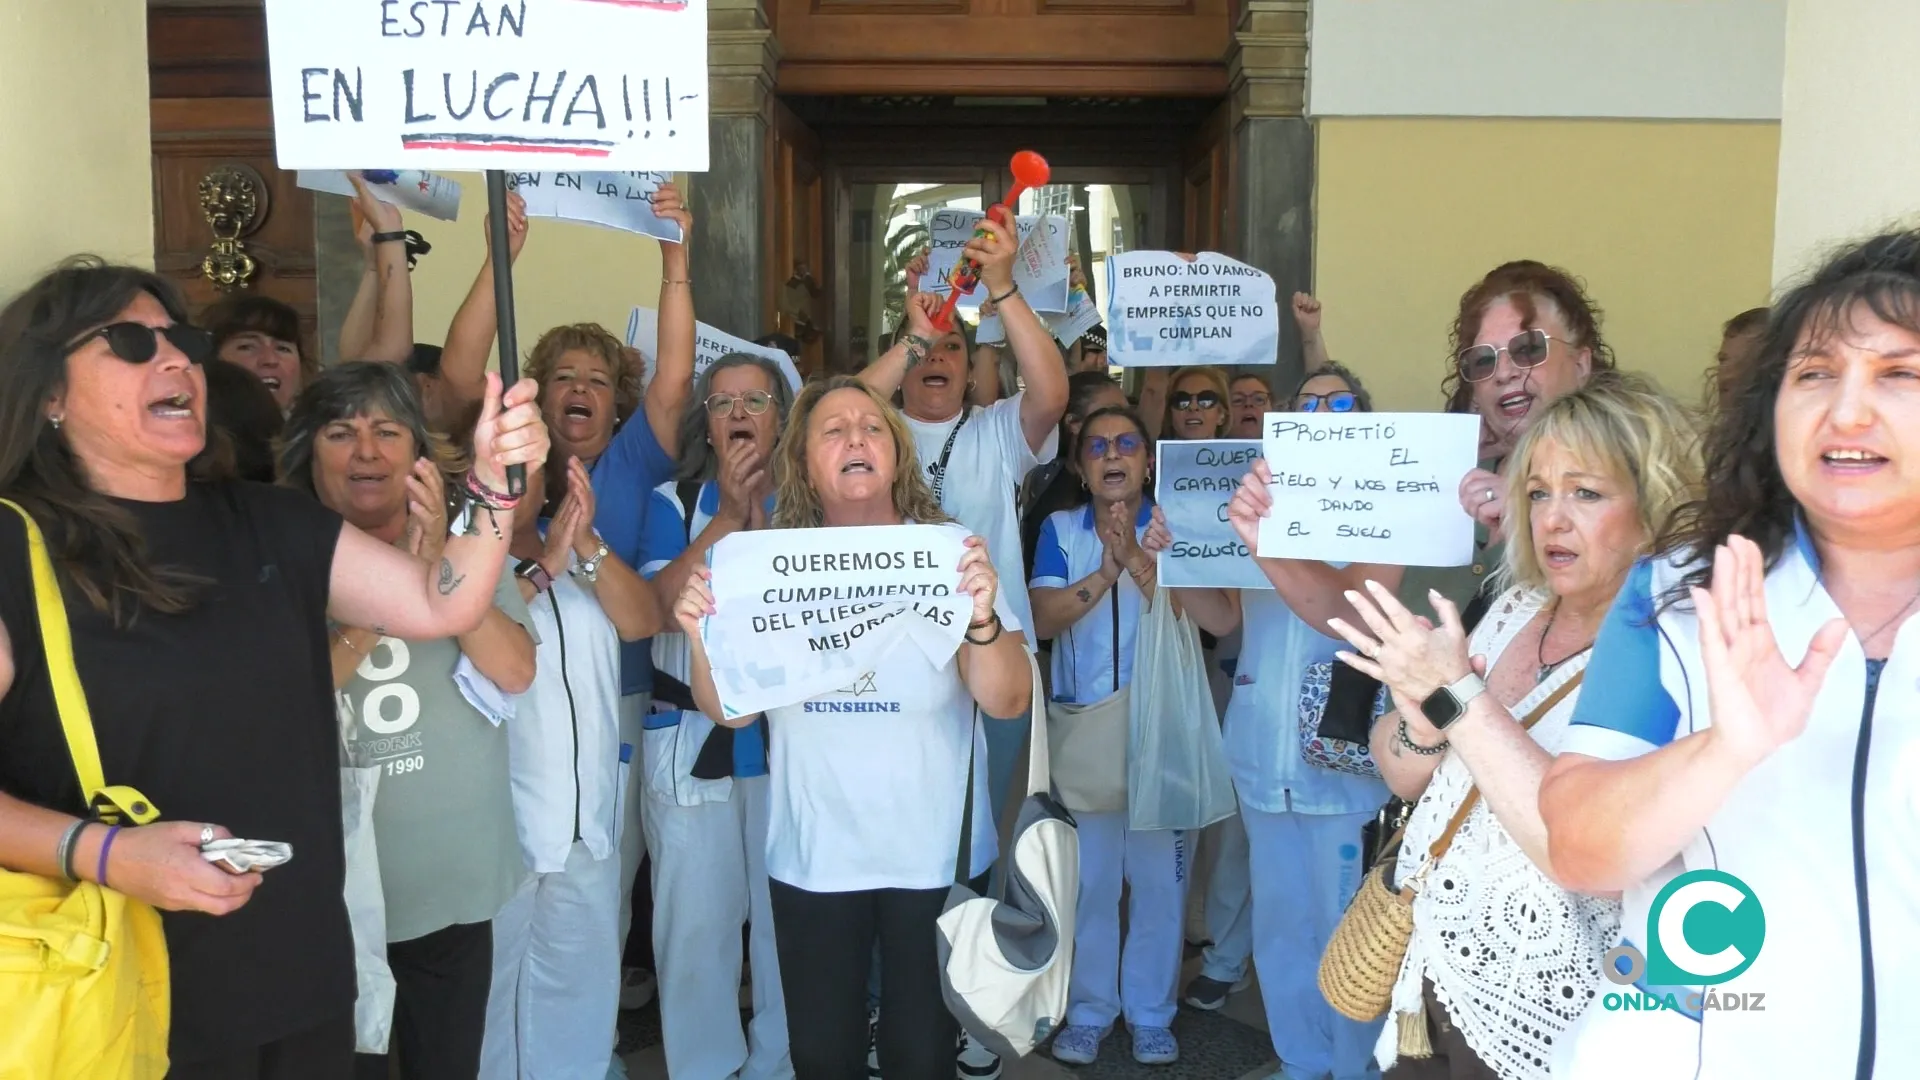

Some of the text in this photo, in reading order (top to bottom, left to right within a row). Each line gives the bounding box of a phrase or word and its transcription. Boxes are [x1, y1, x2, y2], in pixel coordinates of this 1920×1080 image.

[302, 67, 364, 123] EN
[554, 172, 582, 191] EN
[596, 180, 618, 198] LA
[934, 214, 966, 231] SU
[1123, 263, 1263, 279] BRUNO: NO VAMOS
[1149, 284, 1242, 298] A PERMIRTIR
[1127, 305, 1264, 320] EMPRESAS QUE NO
[1159, 326, 1233, 339] CUMPLAN
[1389, 448, 1419, 466] EL
[1173, 477, 1242, 492] GARAN
[1328, 475, 1343, 490] Y
[1355, 479, 1386, 492] NOS
[1320, 498, 1374, 512] DANDO
[1287, 521, 1392, 540] EL SUELO
[1170, 541, 1250, 559] SOLUCIO
[772, 550, 939, 577] QUEREMOS EL
[763, 583, 950, 604] CUMPLIMIENTO
[752, 601, 955, 633] DEL PLIEGO LAS
[803, 701, 901, 714] SUNSHINE
[358, 731, 423, 757] YORK
[386, 755, 425, 777] 1990
